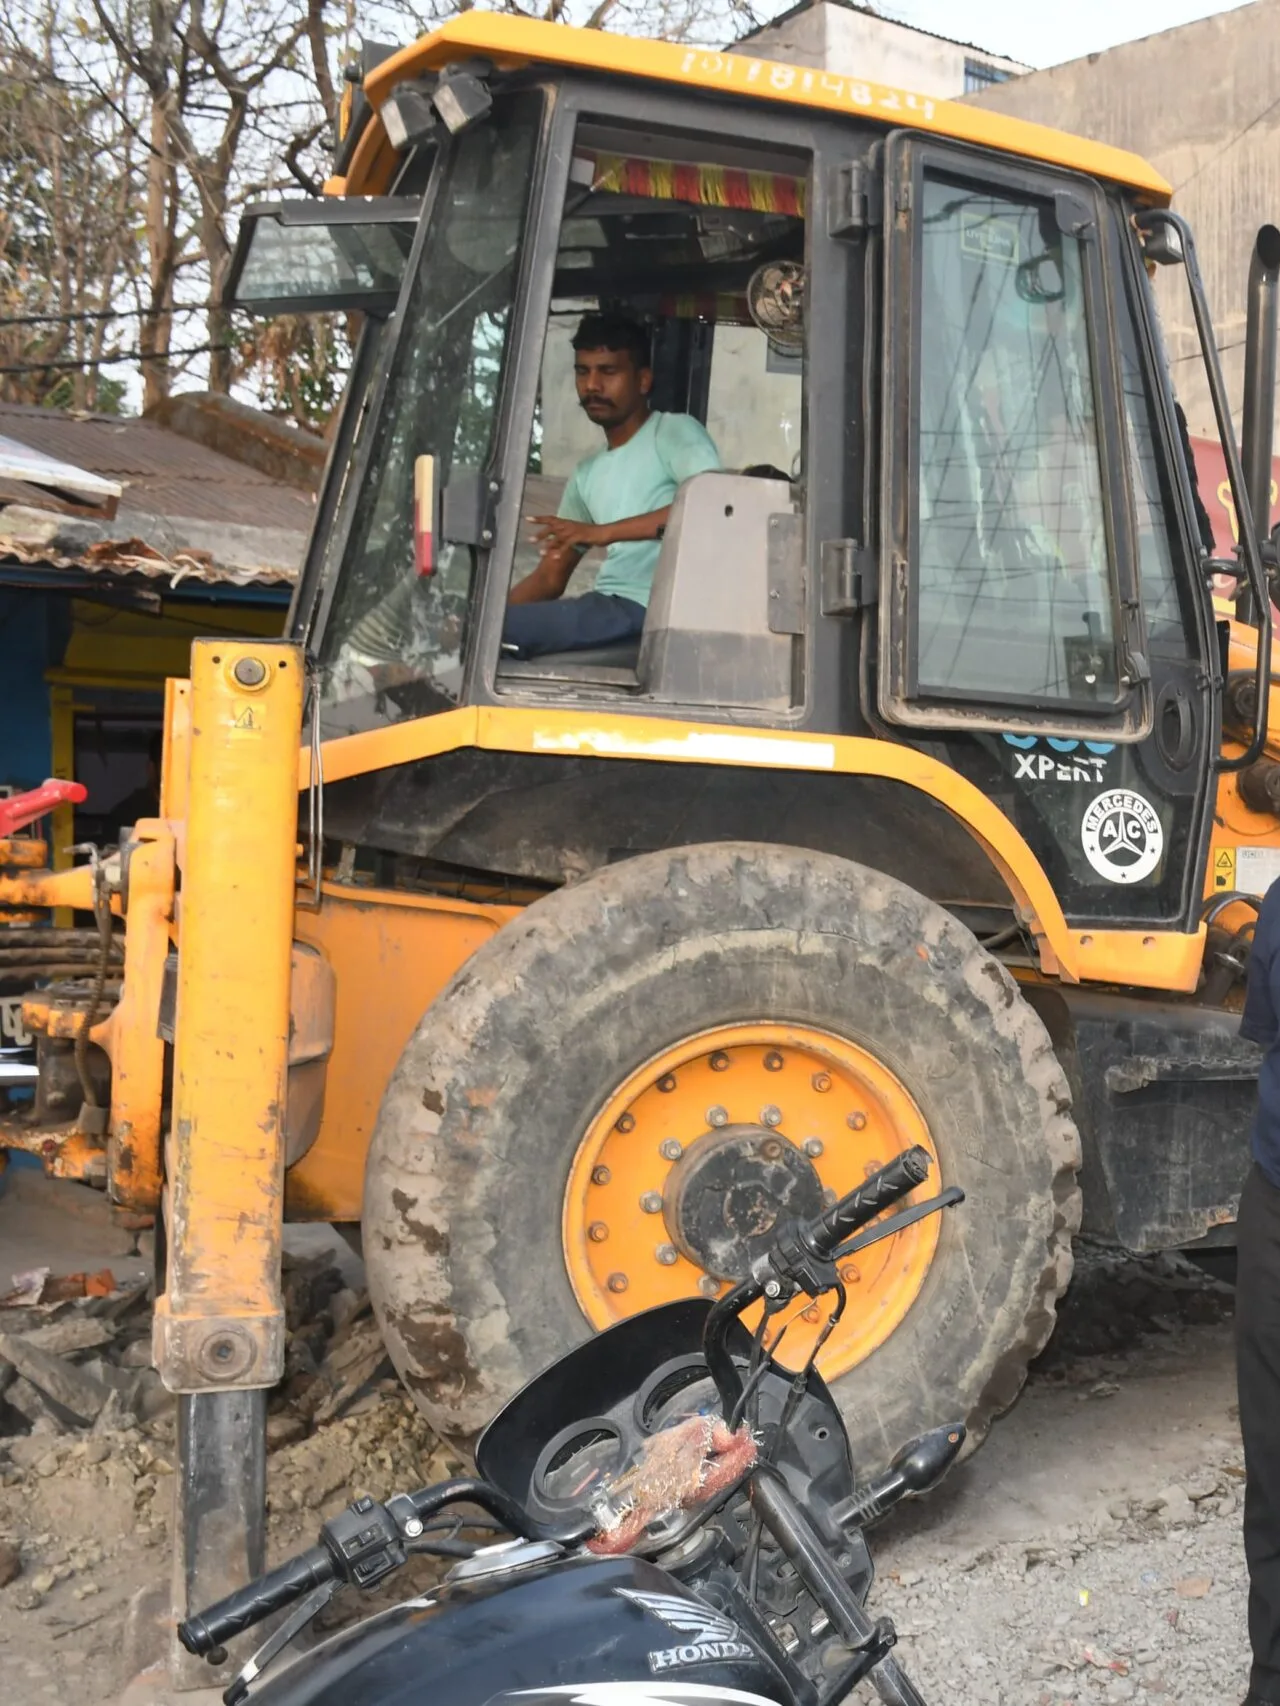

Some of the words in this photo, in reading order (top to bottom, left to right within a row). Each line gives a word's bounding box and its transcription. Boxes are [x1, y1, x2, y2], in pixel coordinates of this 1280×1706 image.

[1014, 752, 1107, 783] XPERT
[1085, 793, 1159, 835] MERCEDES
[1102, 819, 1119, 838] A
[1126, 819, 1142, 839] C
[654, 1641, 755, 1669] HONDA
